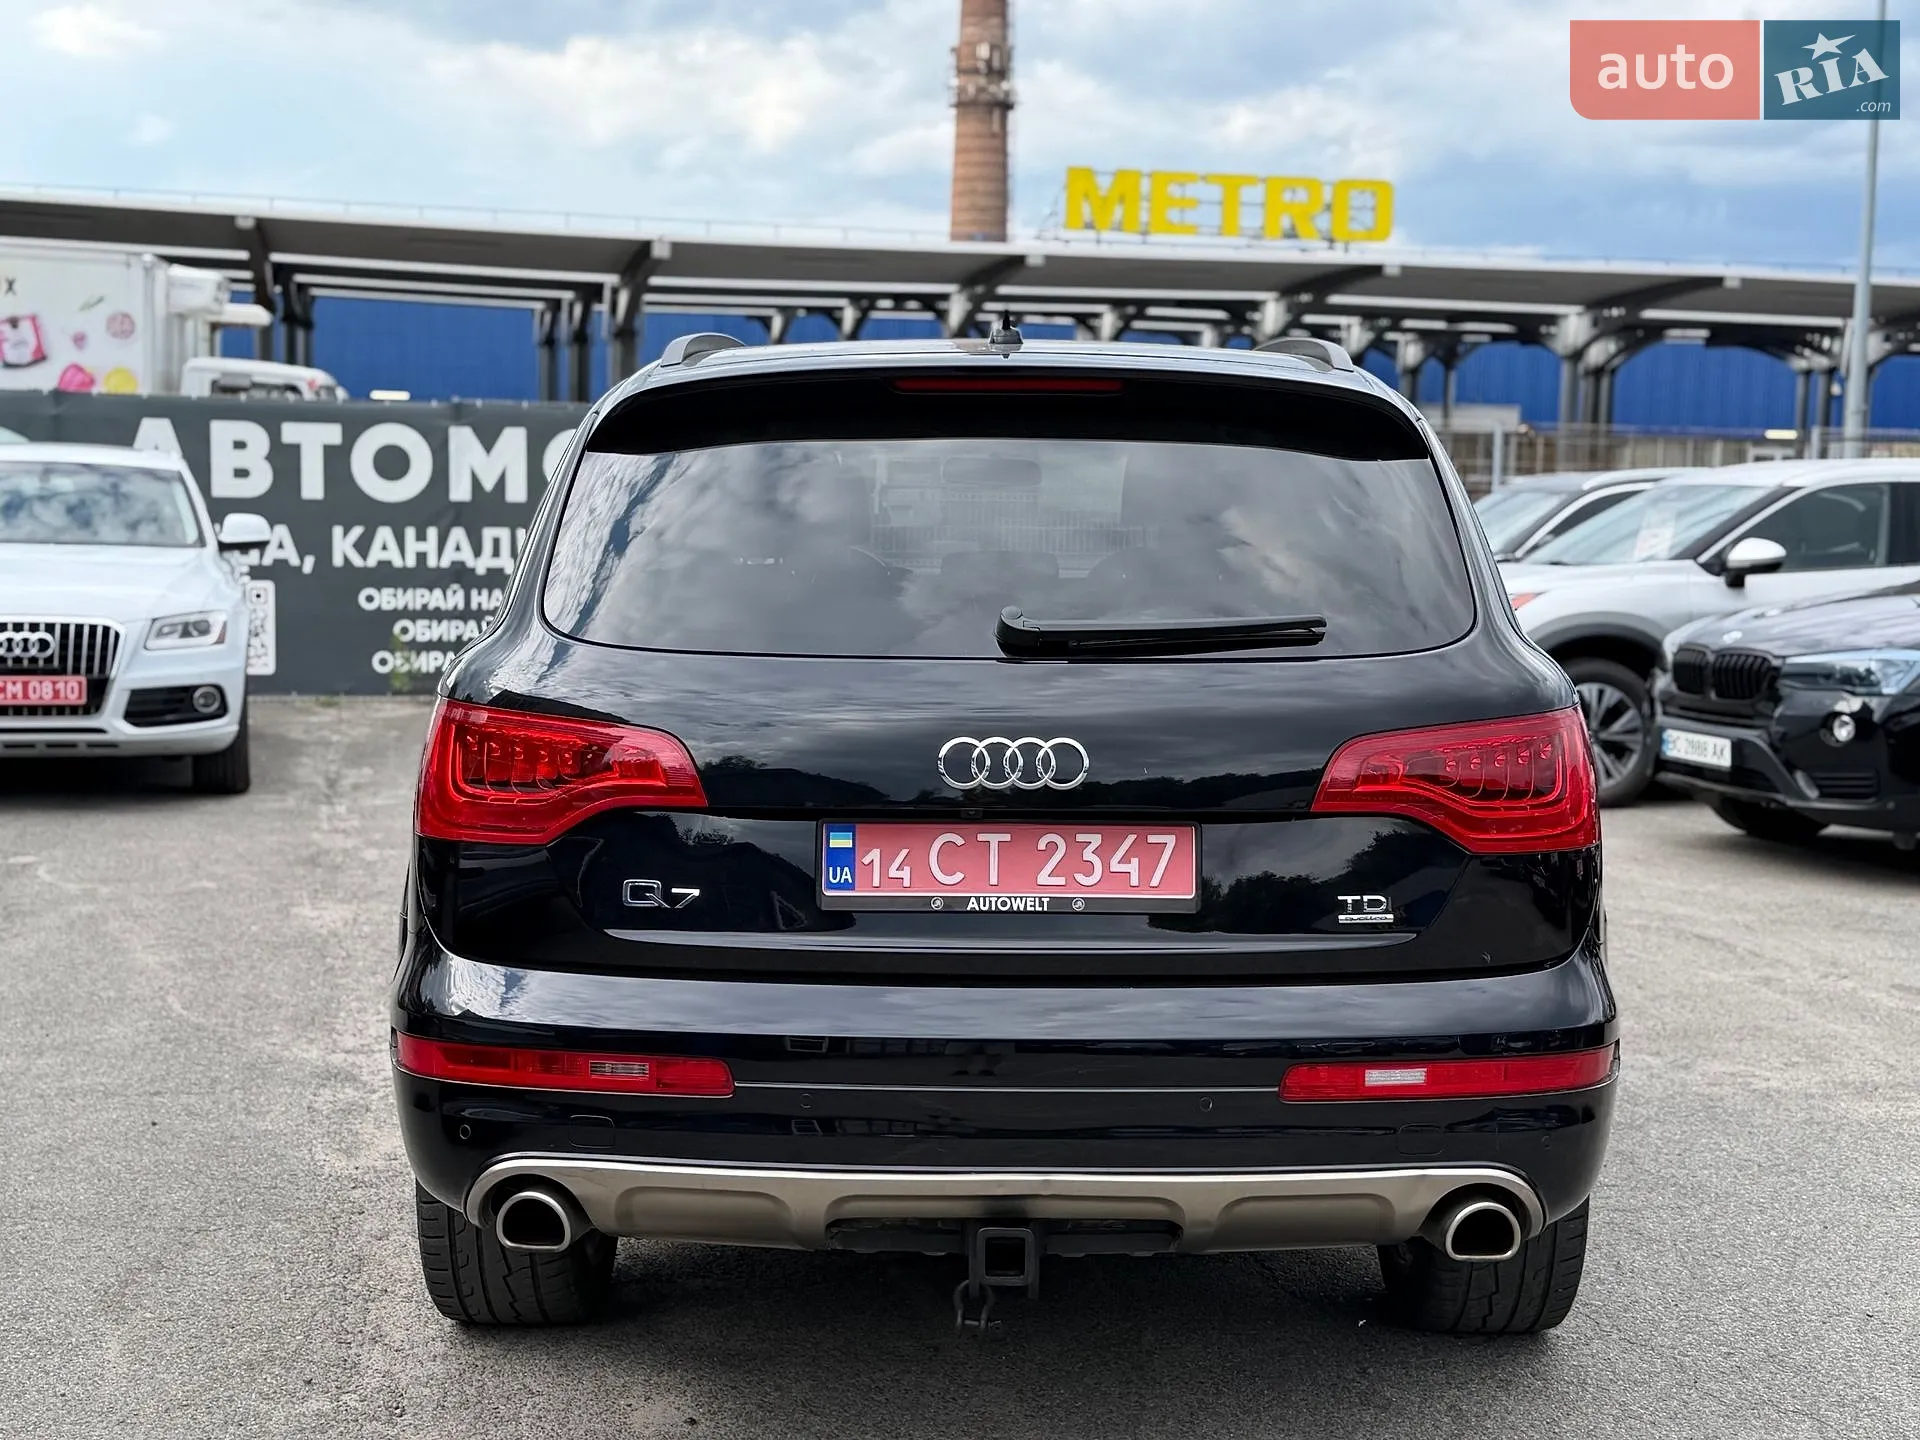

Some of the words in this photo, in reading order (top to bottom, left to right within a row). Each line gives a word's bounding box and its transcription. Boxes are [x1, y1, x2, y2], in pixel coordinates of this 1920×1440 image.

[1063, 166, 1395, 242] METRO
[358, 583, 465, 611] ОБИРАЙ
[28, 680, 80, 700] 0810
[861, 848, 912, 888] 14
[928, 832, 1012, 887] CT
[1036, 833, 1177, 888] 2347
[829, 866, 853, 885] UA
[622, 878, 701, 909] Q7
[966, 896, 1051, 912] AUTOWELT
